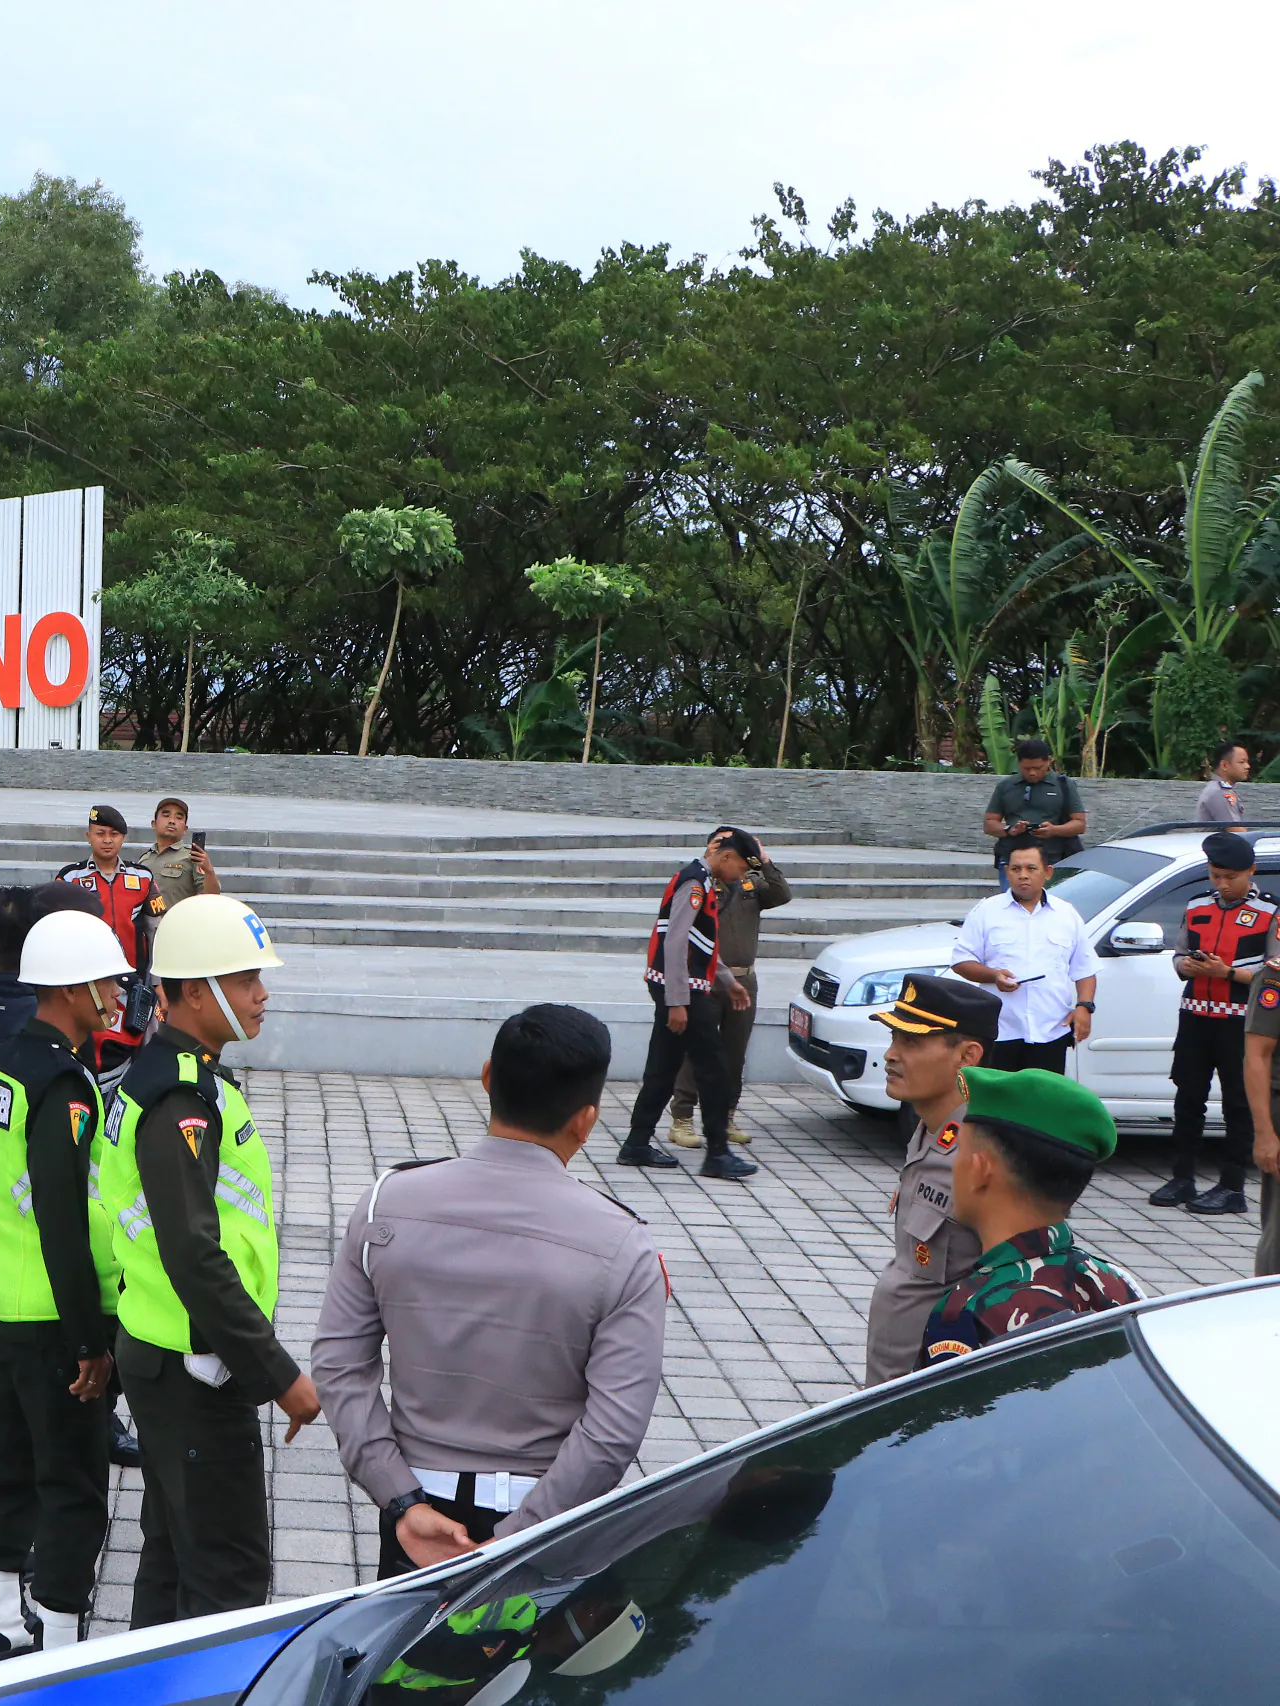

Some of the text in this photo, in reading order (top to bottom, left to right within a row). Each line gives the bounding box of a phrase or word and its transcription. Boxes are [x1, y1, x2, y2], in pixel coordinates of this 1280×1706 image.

[242, 913, 265, 950] P
[73, 1112, 85, 1122] PM
[186, 1130, 204, 1141] PM
[917, 1183, 949, 1208] POLRI
[930, 1342, 950, 1356] KODIM
